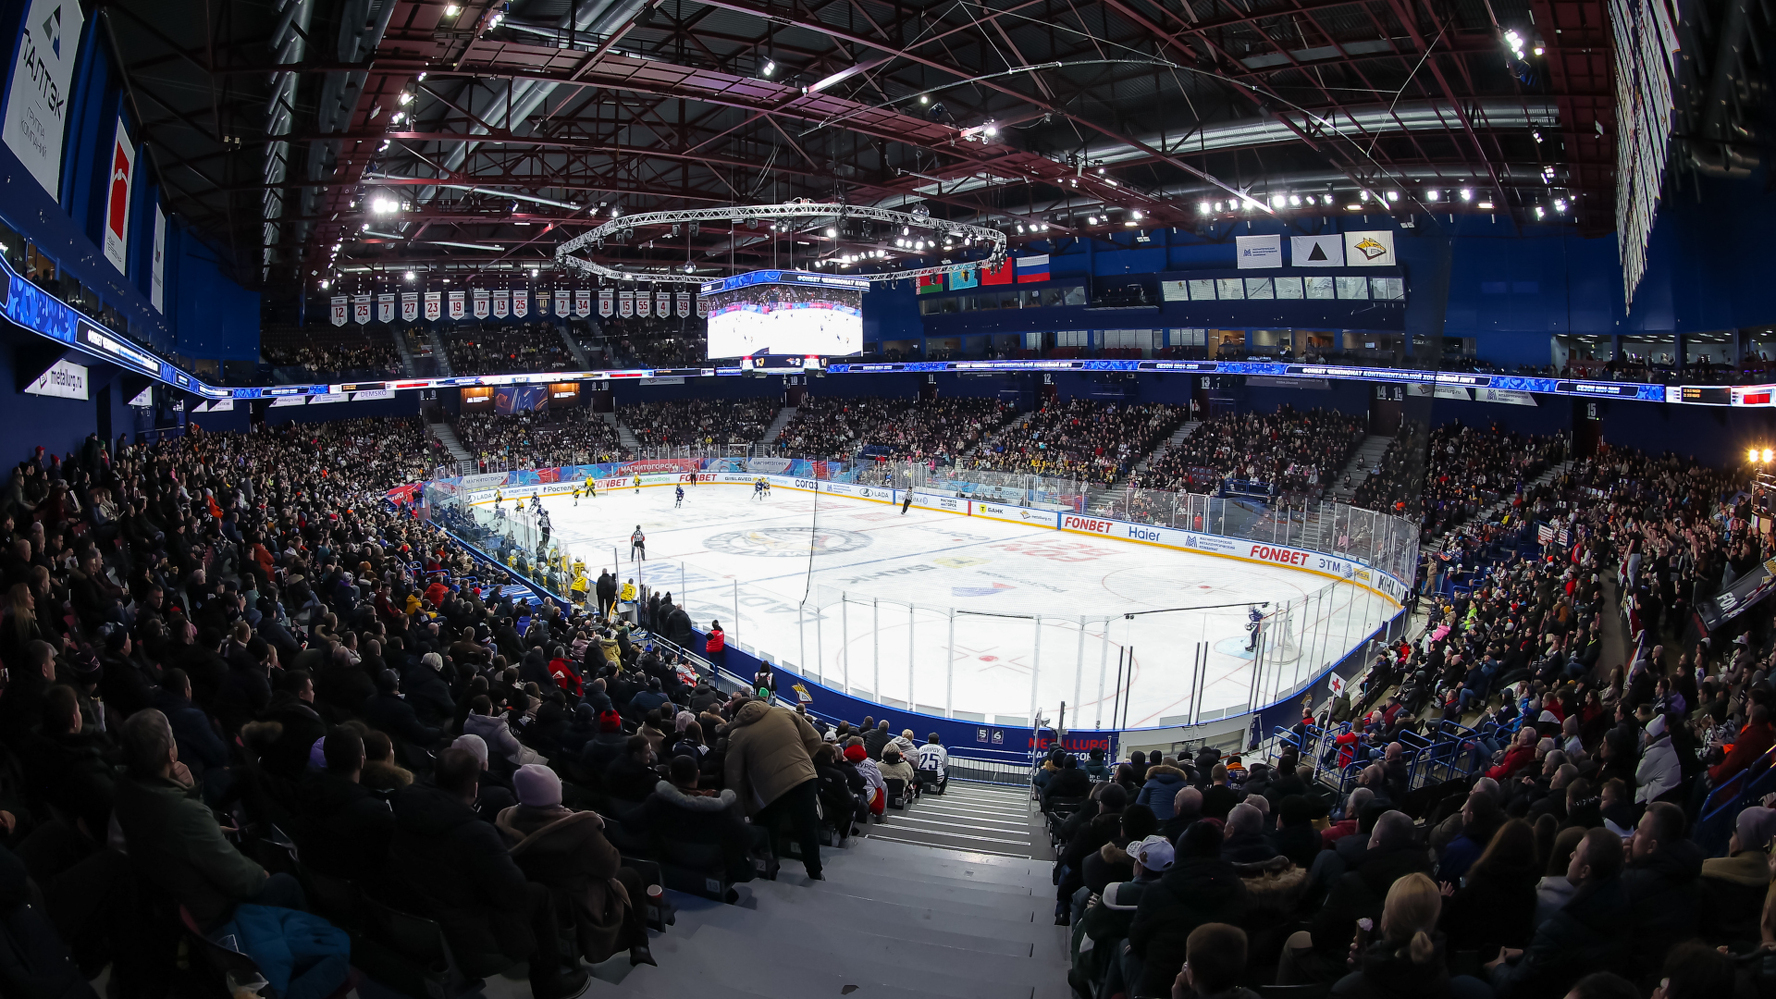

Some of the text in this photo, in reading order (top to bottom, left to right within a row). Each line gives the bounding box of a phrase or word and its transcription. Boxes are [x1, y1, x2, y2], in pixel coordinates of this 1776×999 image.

[383, 304, 389, 314] 7
[404, 303, 415, 313] 27
[427, 302, 438, 312] 23
[453, 301, 461, 311] 19
[477, 301, 486, 310] 17
[497, 300, 505, 310] 13
[515, 299, 526, 309] 25
[560, 300, 565, 310] 7
[577, 300, 588, 310] 34
[603, 301, 608, 310] 8
[622, 301, 630, 311] 15
[638, 301, 648, 310] 55
[660, 301, 665, 311] 4
[679, 301, 688, 311] 39
[698, 302, 708, 311] 36
[335, 307, 344, 318] 12
[357, 305, 368, 316] 25
[51, 369, 82, 392] metallurg.ru
[1043, 373, 1051, 382] 12
[1200, 376, 1210, 387] 13
[1376, 385, 1386, 398] 14
[1586, 403, 1596, 417] 15
[475, 492, 492, 500] LADA
[874, 490, 889, 498] LADA
[1064, 516, 1113, 533] FONBET
[1128, 526, 1160, 541] Haier
[1250, 545, 1310, 565] FONBET
[1318, 558, 1340, 572] ЭТМ
[978, 729, 986, 738] 5
[993, 731, 1001, 739] 6
[920, 753, 938, 770] 25
[707, 881, 719, 891] 13
